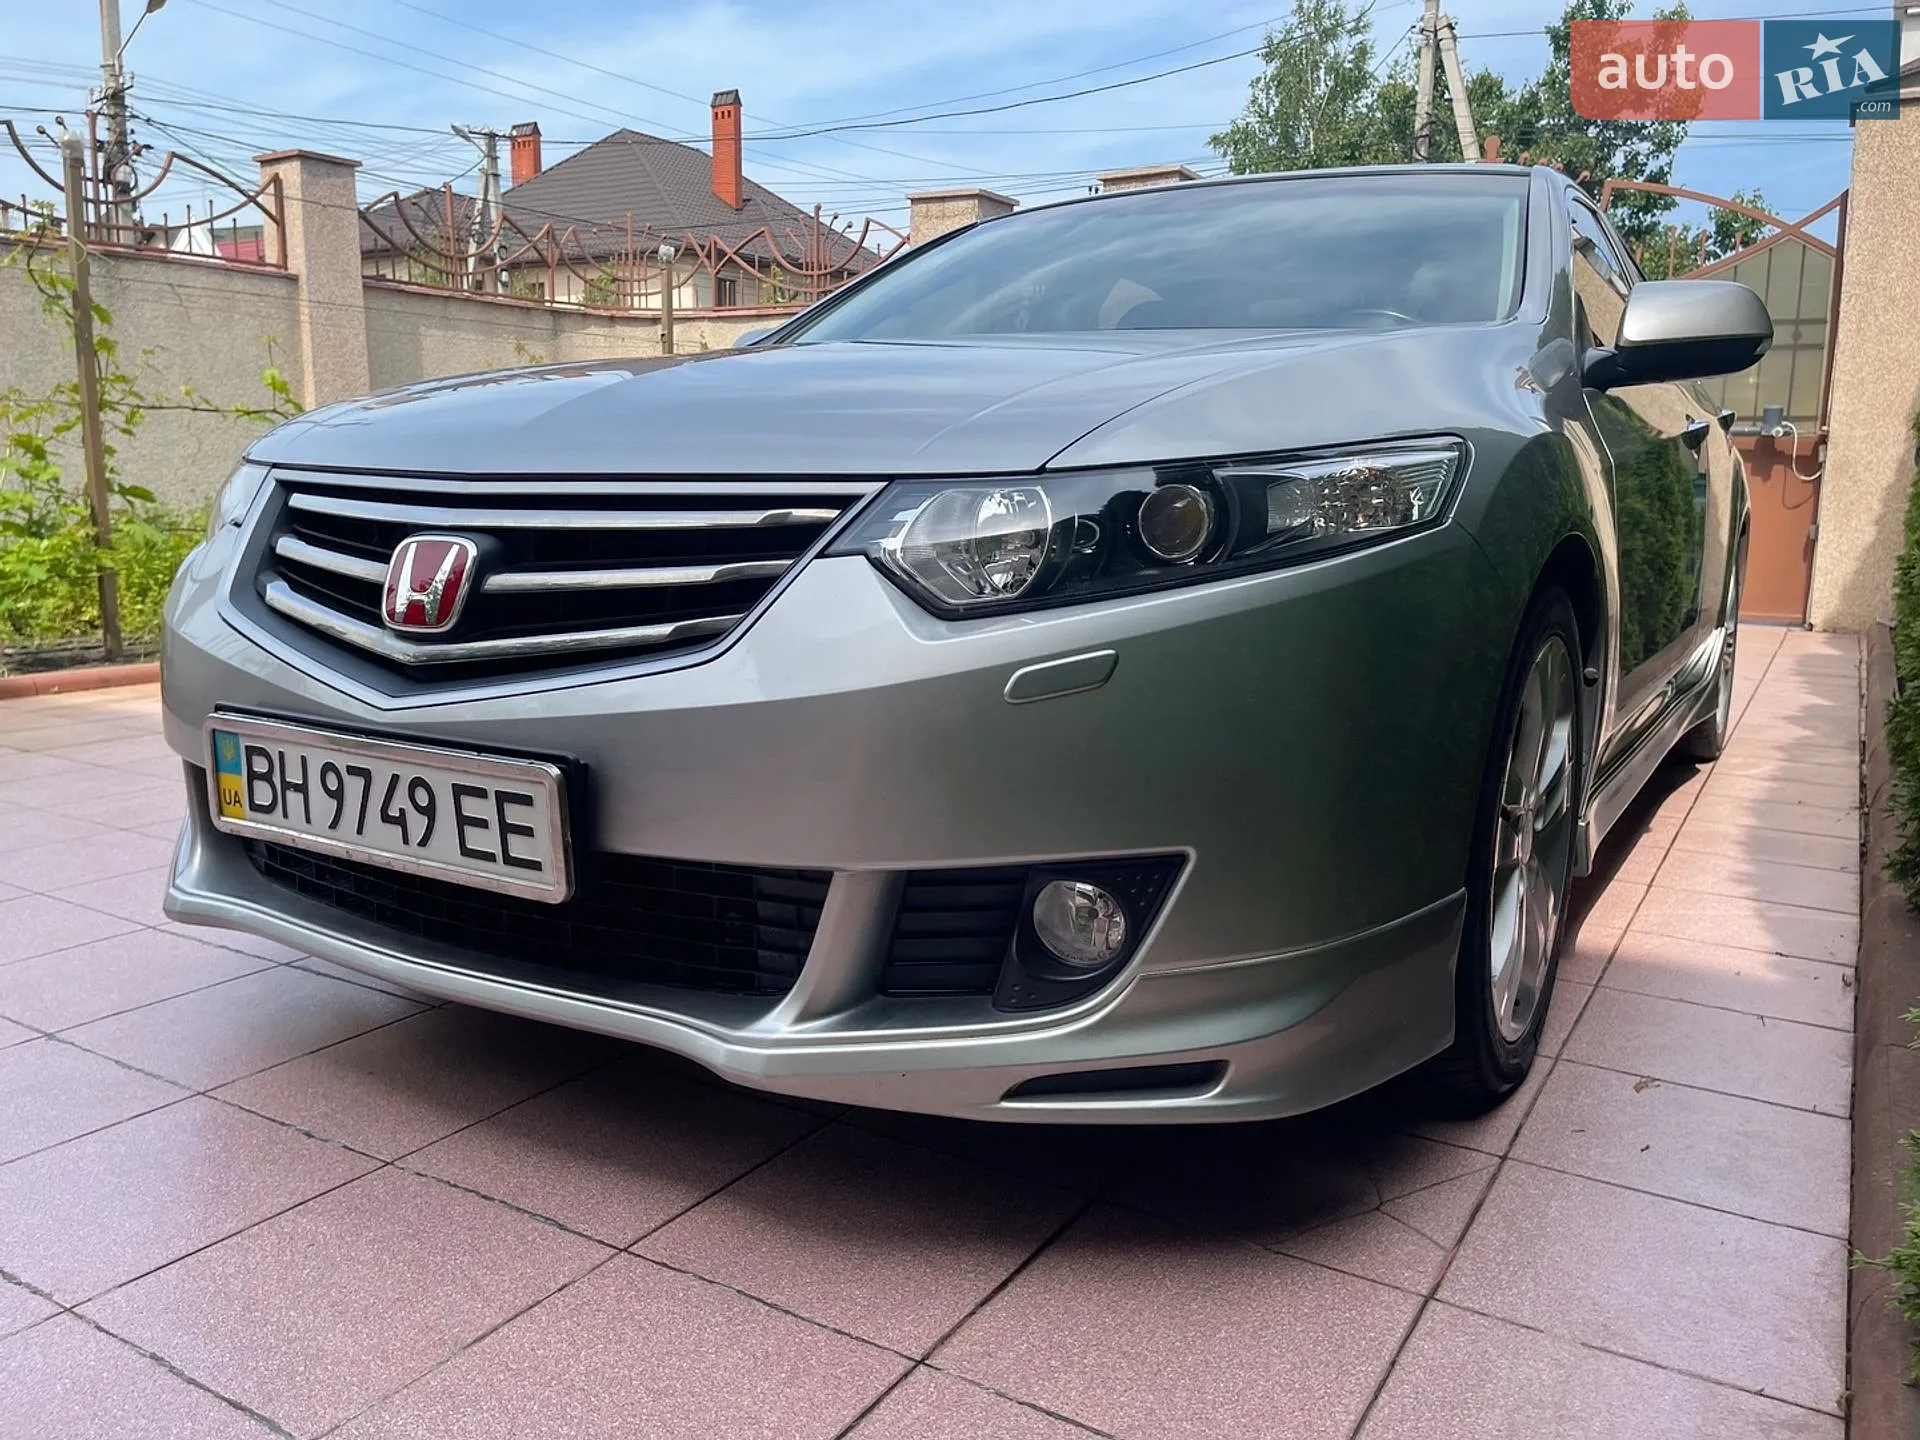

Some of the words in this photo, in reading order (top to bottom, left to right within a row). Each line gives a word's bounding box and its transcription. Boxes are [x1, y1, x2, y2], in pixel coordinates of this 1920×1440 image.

[223, 787, 243, 808] UA
[245, 745, 312, 824] BH
[320, 761, 436, 847] 9749
[451, 783, 543, 871] EE
